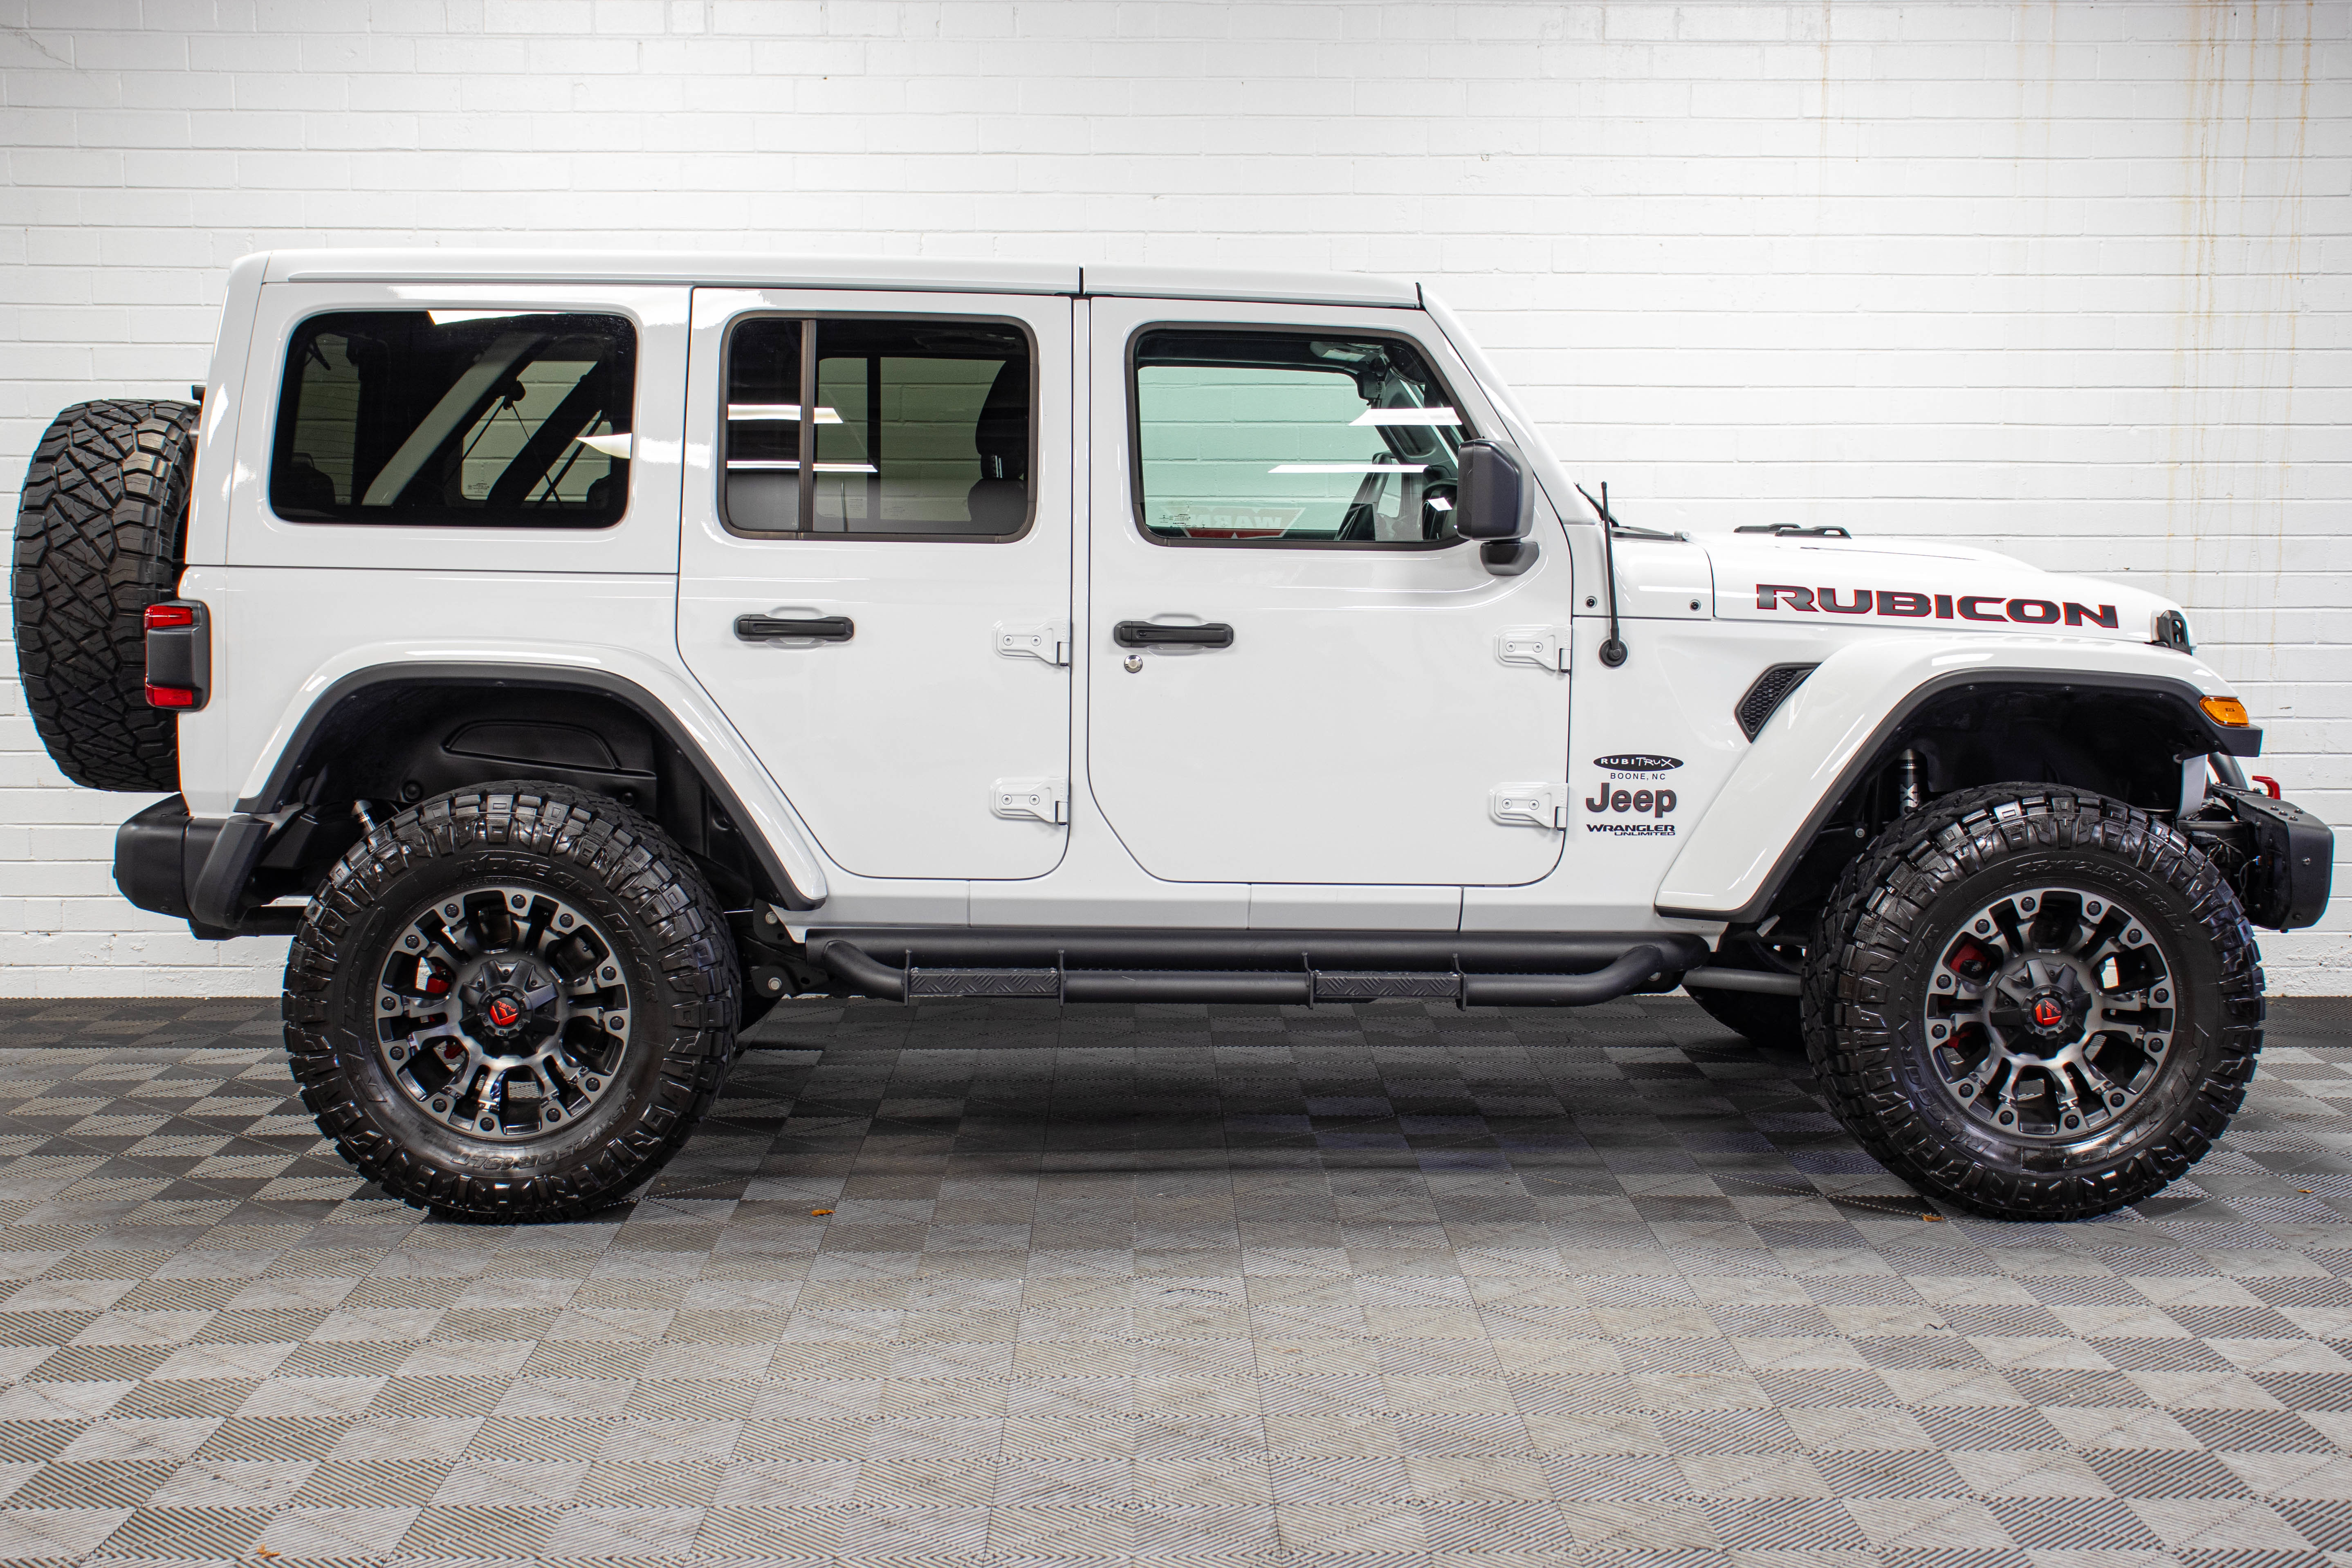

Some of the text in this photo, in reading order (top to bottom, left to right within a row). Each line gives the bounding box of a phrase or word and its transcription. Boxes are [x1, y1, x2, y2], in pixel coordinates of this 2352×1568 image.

[1756, 584, 2119, 628] RUBICON
[1586, 782, 1676, 818] Jeep
[456, 854, 551, 877] RIDGE
[497, 1001, 516, 1012] FUEL
